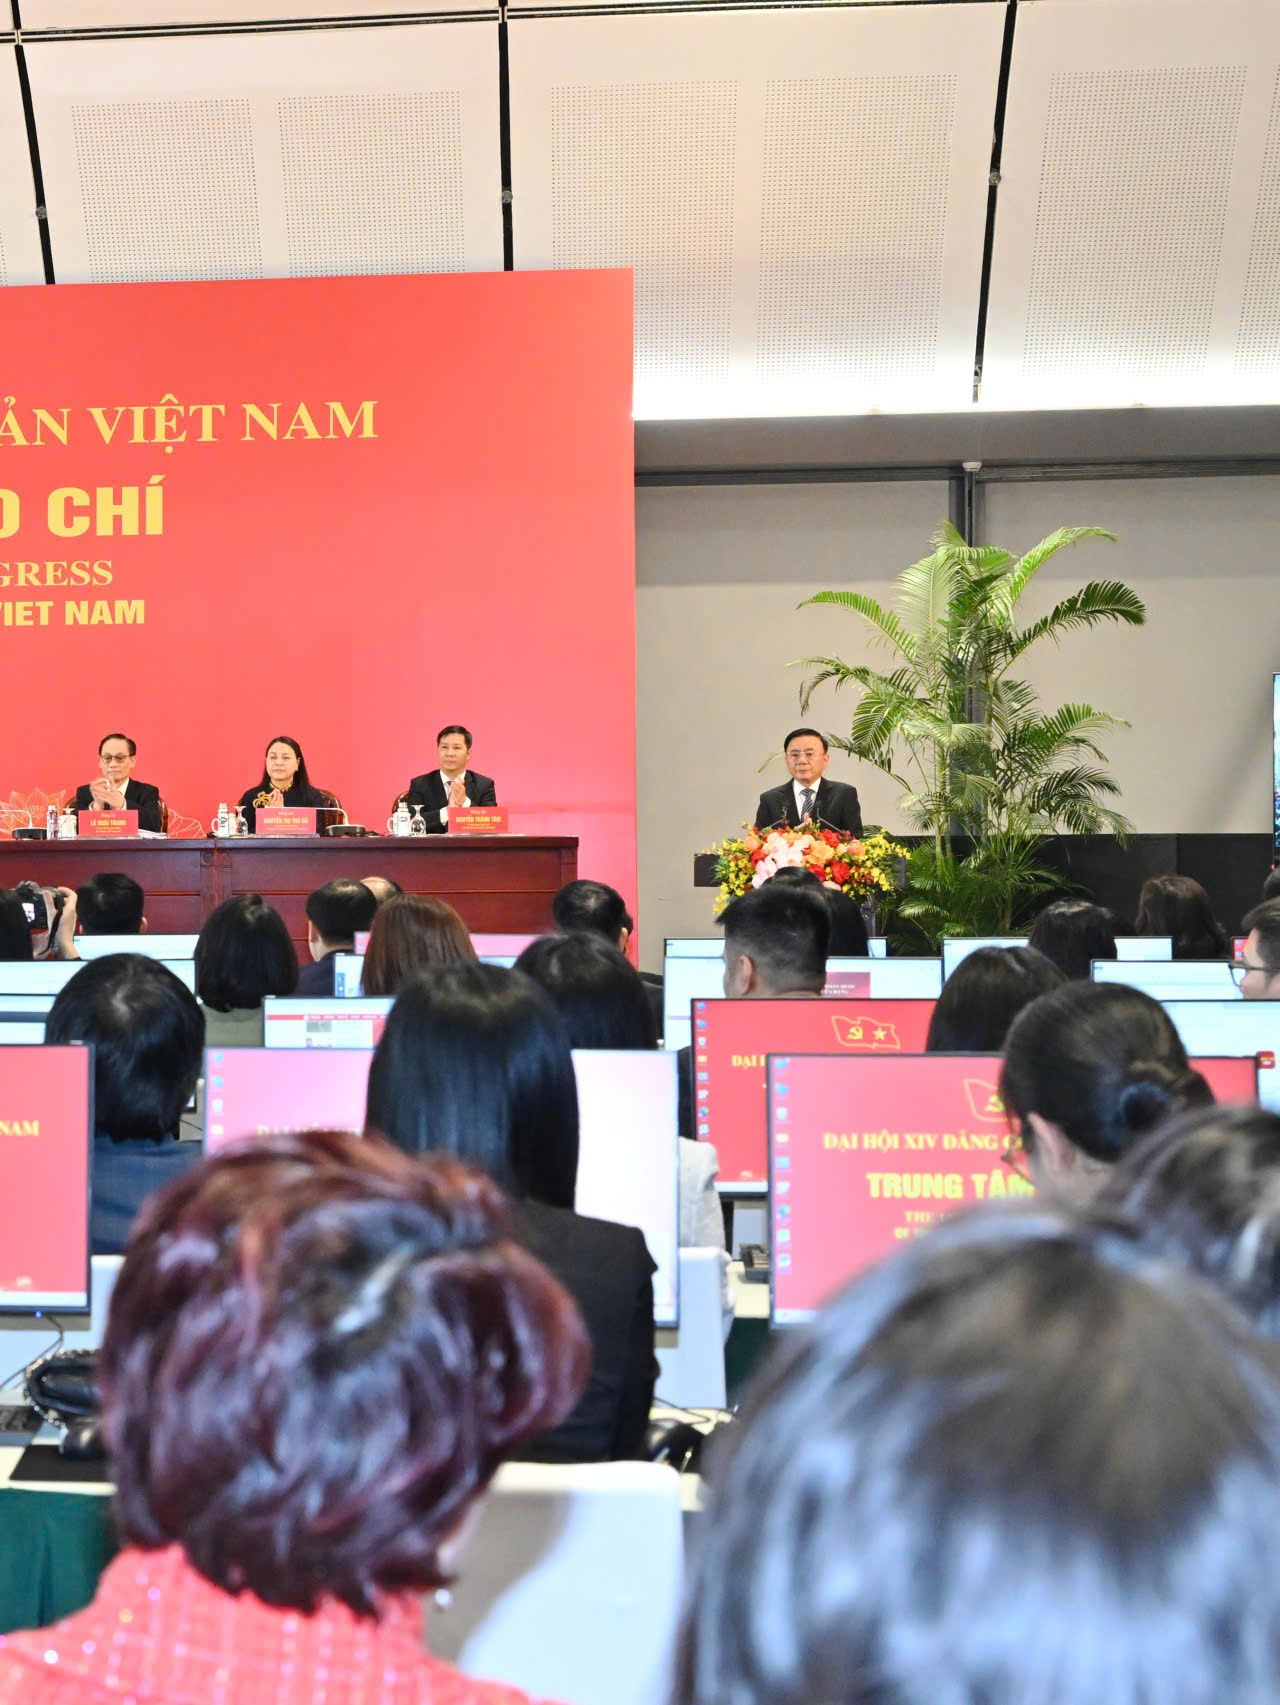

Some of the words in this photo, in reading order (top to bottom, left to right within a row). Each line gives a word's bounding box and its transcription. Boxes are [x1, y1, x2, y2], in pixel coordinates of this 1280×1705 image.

[88, 394, 225, 453] VIỆT
[241, 401, 378, 440] NAM
[48, 475, 165, 537] CHÍ
[65, 600, 144, 625] NAM
[863, 1129, 899, 1152] HỘI
[904, 1133, 936, 1149] XIV
[866, 1172, 963, 1198] TRUNG
